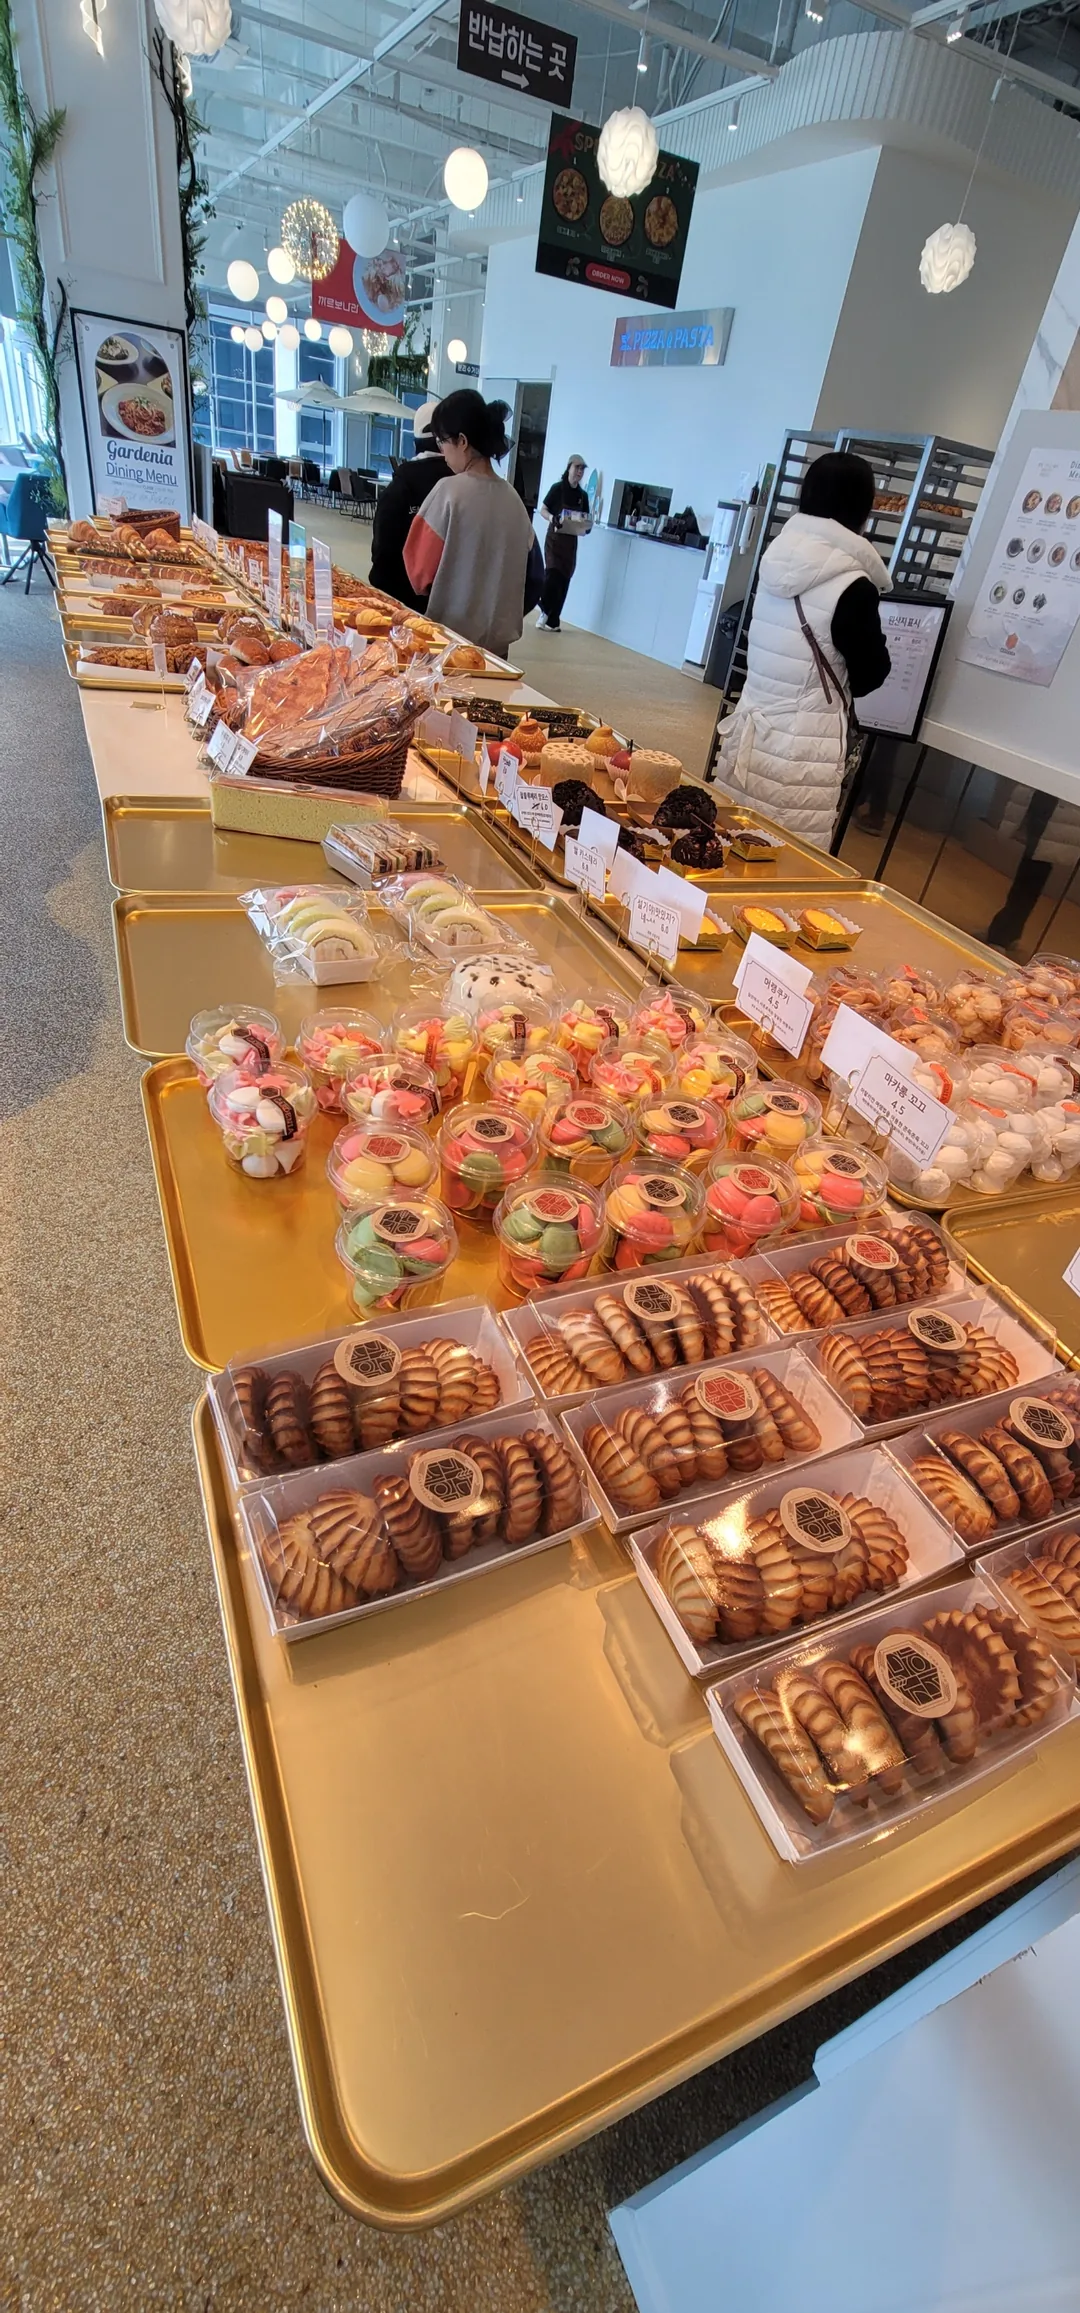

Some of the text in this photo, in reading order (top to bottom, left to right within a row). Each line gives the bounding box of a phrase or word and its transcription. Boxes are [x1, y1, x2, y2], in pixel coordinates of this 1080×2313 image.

[468, 10, 567, 81] 반납하는 곳
[633, 329, 665, 350] PIZZA
[674, 326, 714, 348] PASTA
[106, 440, 173, 466] Gardenia
[106, 462, 177, 485] Dining Menu
[763, 977, 790, 1005] 머랭쿠키
[767, 996, 780, 1010] 4.5
[883, 1072, 909, 1099] 마카롱
[890, 1101, 907, 1116] 4.5
